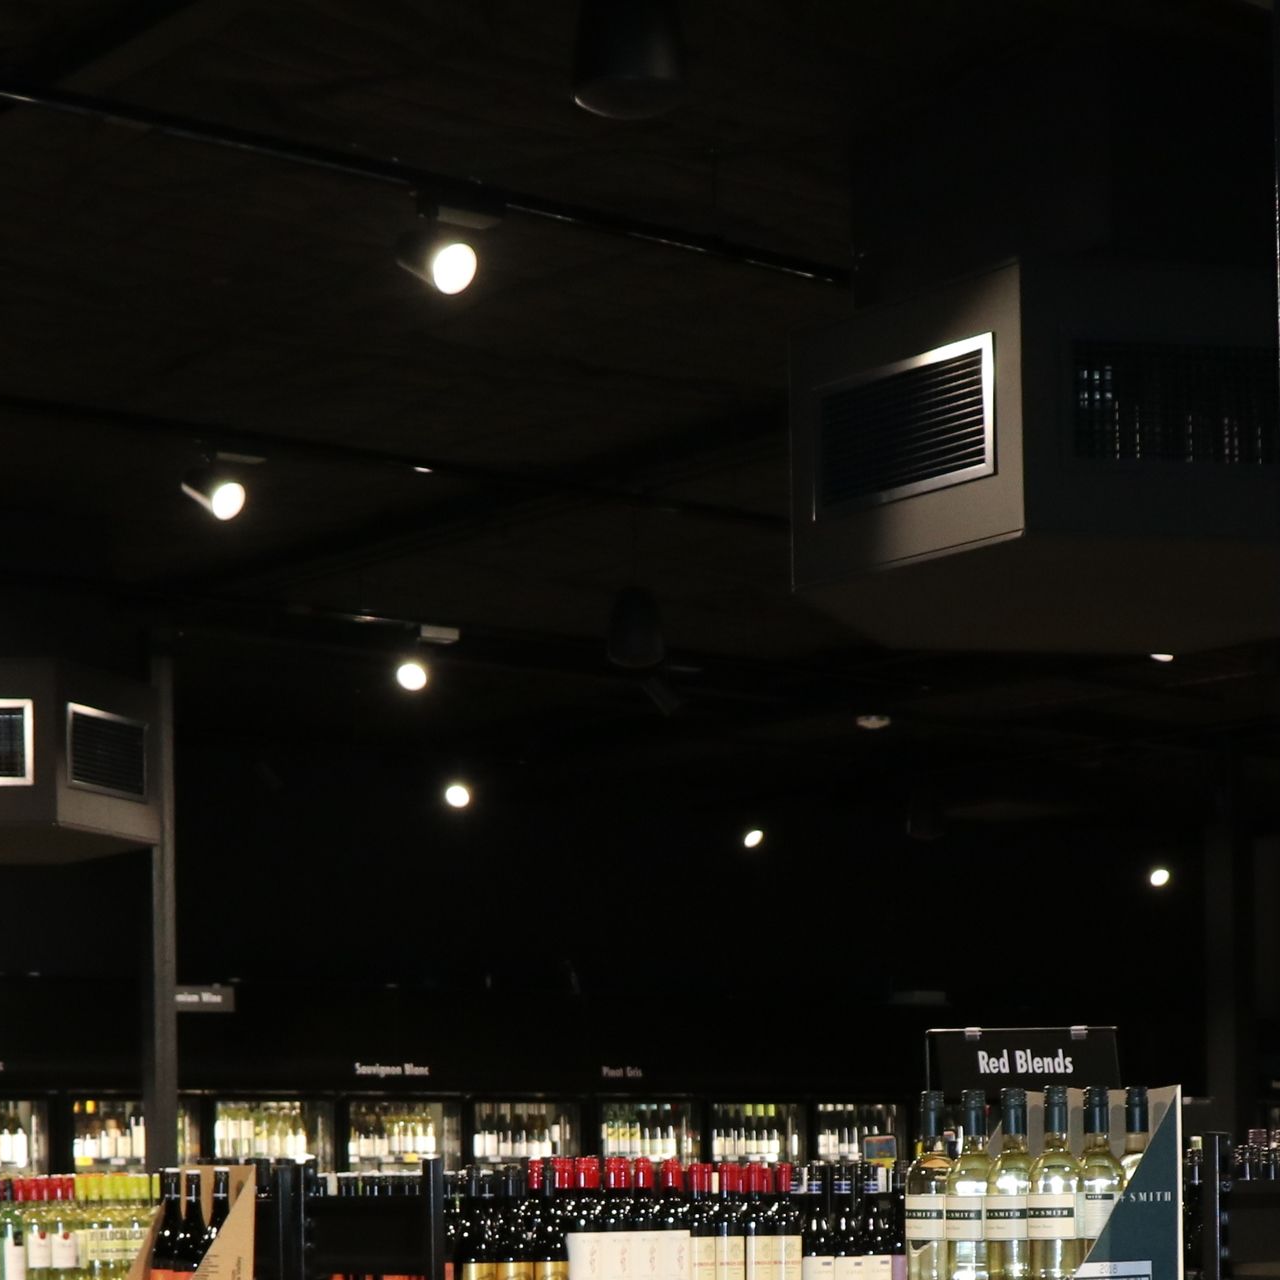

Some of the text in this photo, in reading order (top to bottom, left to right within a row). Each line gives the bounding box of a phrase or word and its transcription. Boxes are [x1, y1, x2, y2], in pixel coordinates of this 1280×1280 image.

[978, 1049, 1074, 1074] Red Blends
[355, 1062, 429, 1078] Sauvignon Blanc
[602, 1065, 642, 1078] Pinot Gris
[1130, 1192, 1172, 1202] SMITH
